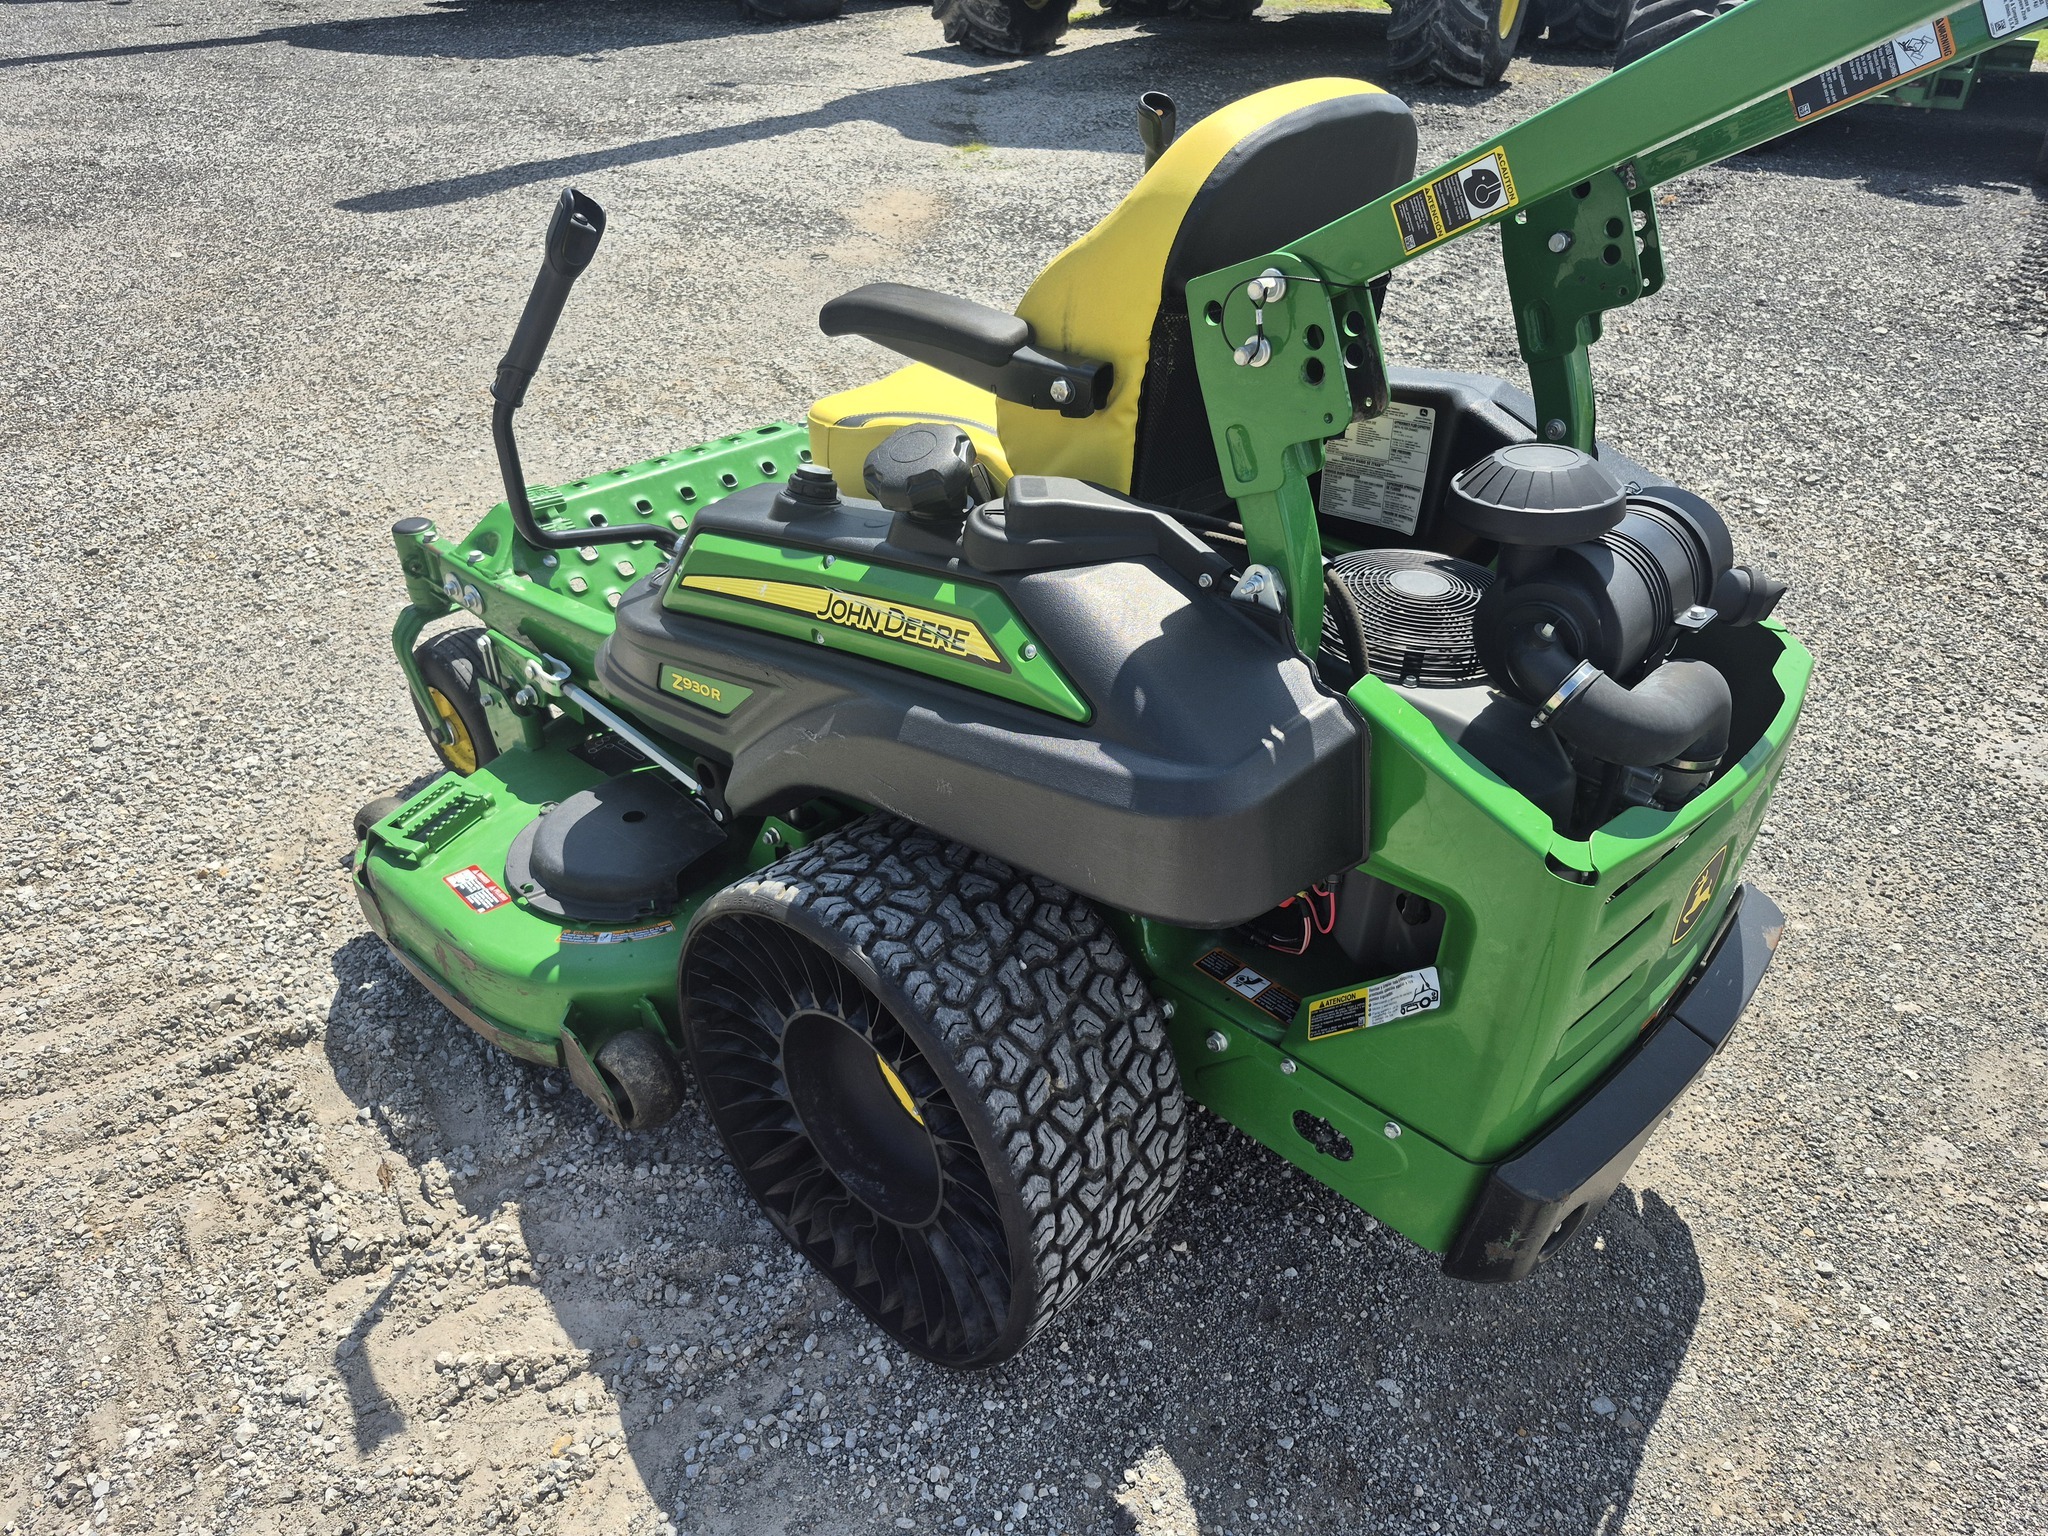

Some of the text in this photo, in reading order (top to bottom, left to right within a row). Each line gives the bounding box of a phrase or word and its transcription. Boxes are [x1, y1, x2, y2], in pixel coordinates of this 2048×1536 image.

[1937, 21, 1953, 57] WARNING
[1499, 160, 1516, 201] CAUTION
[1426, 192, 1444, 237] ATENCIÓN
[817, 592, 970, 653] JOHN DEERE
[671, 673, 721, 702] Z930R
